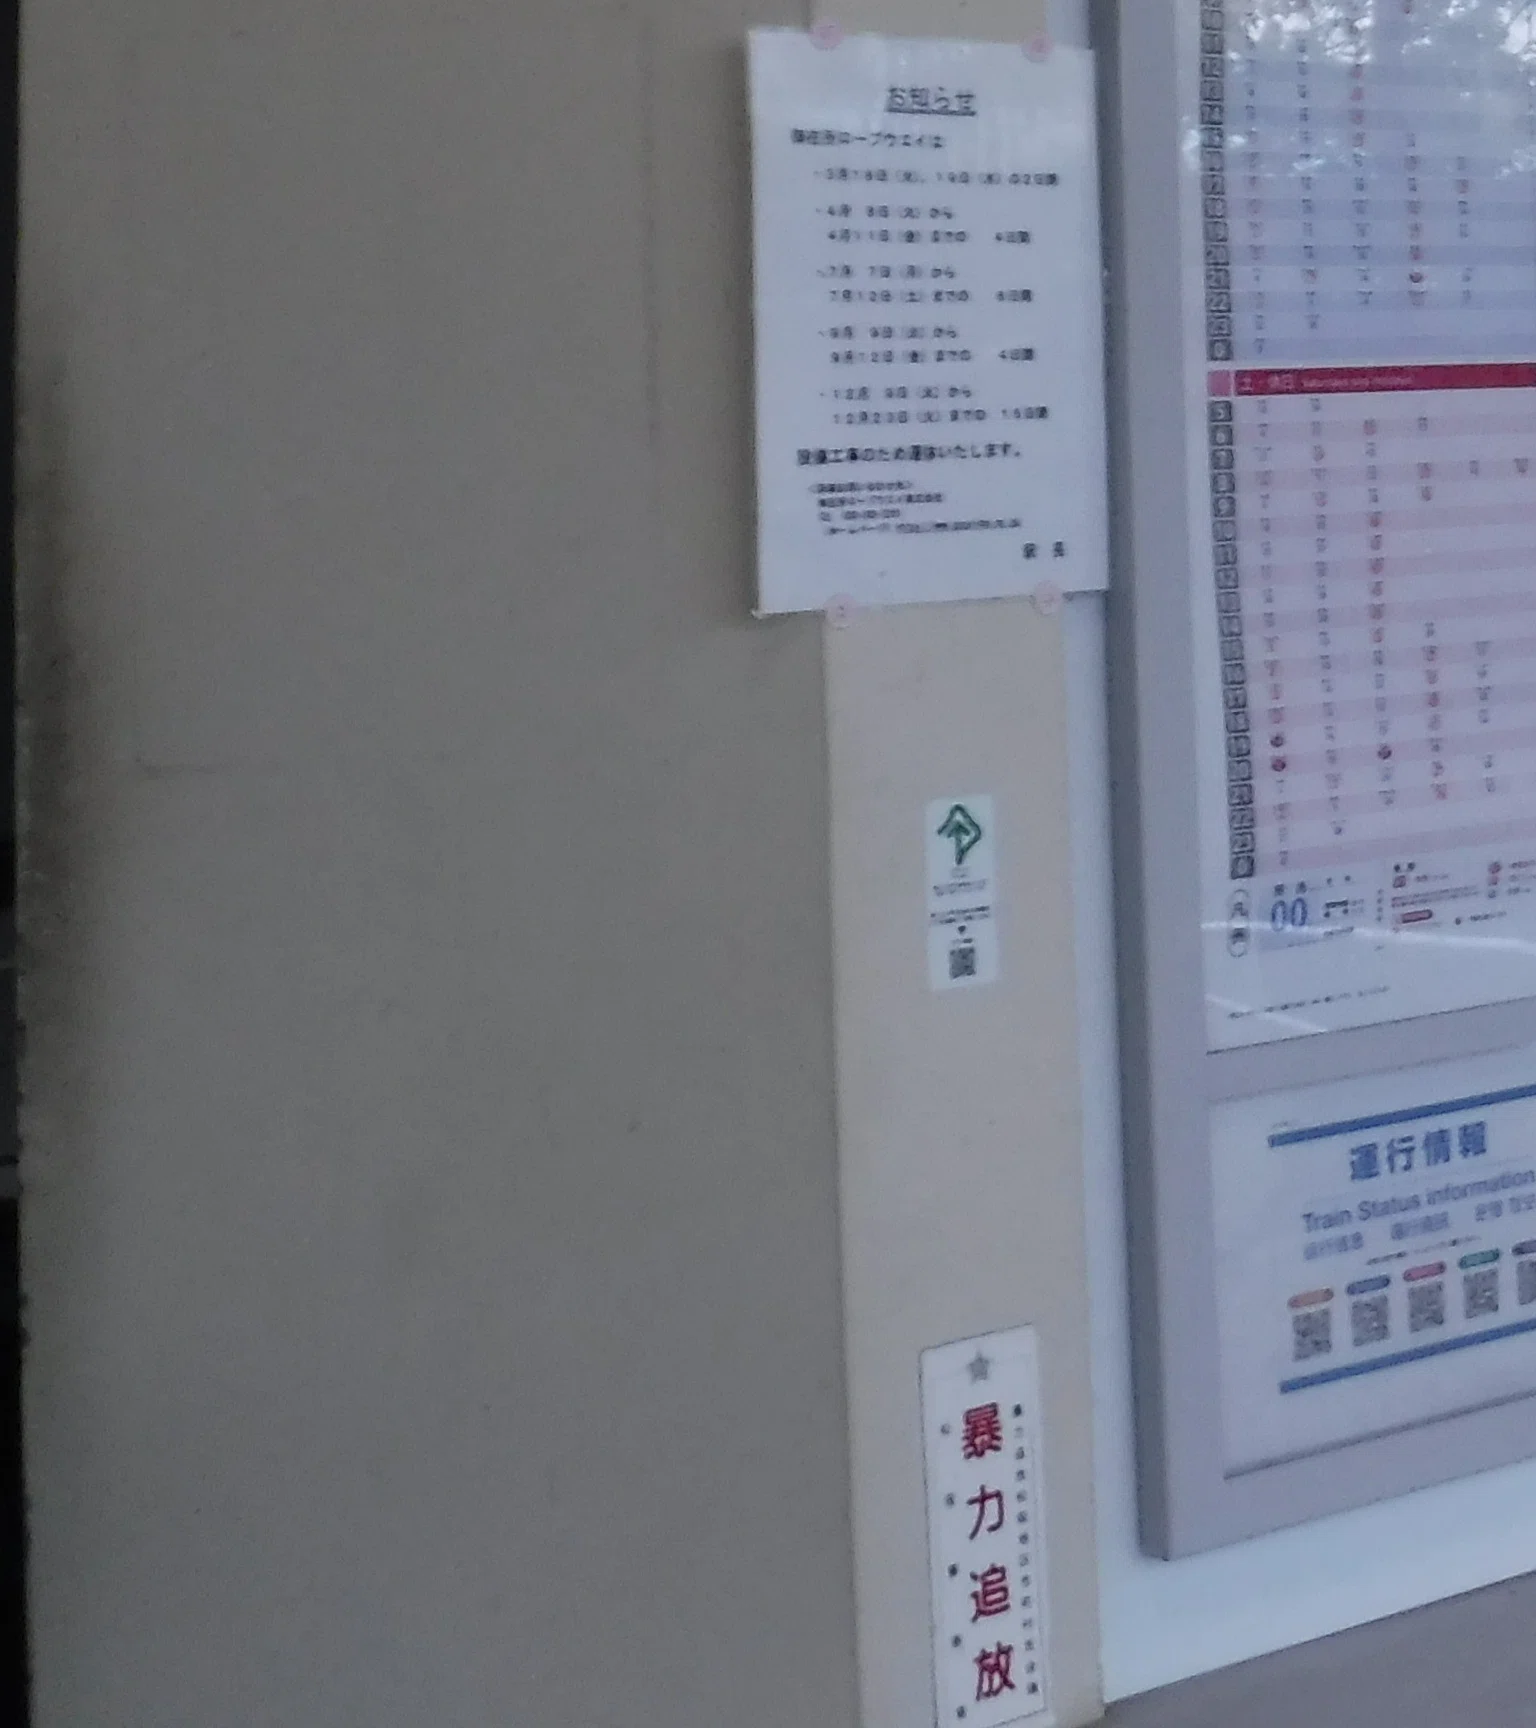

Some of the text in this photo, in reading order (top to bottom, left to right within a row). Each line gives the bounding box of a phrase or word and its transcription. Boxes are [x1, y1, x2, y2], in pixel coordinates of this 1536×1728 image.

[1302, 1208, 1353, 1234] Train
[1357, 1193, 1421, 1222] Status
[961, 1400, 1016, 1703] 暴力追放
